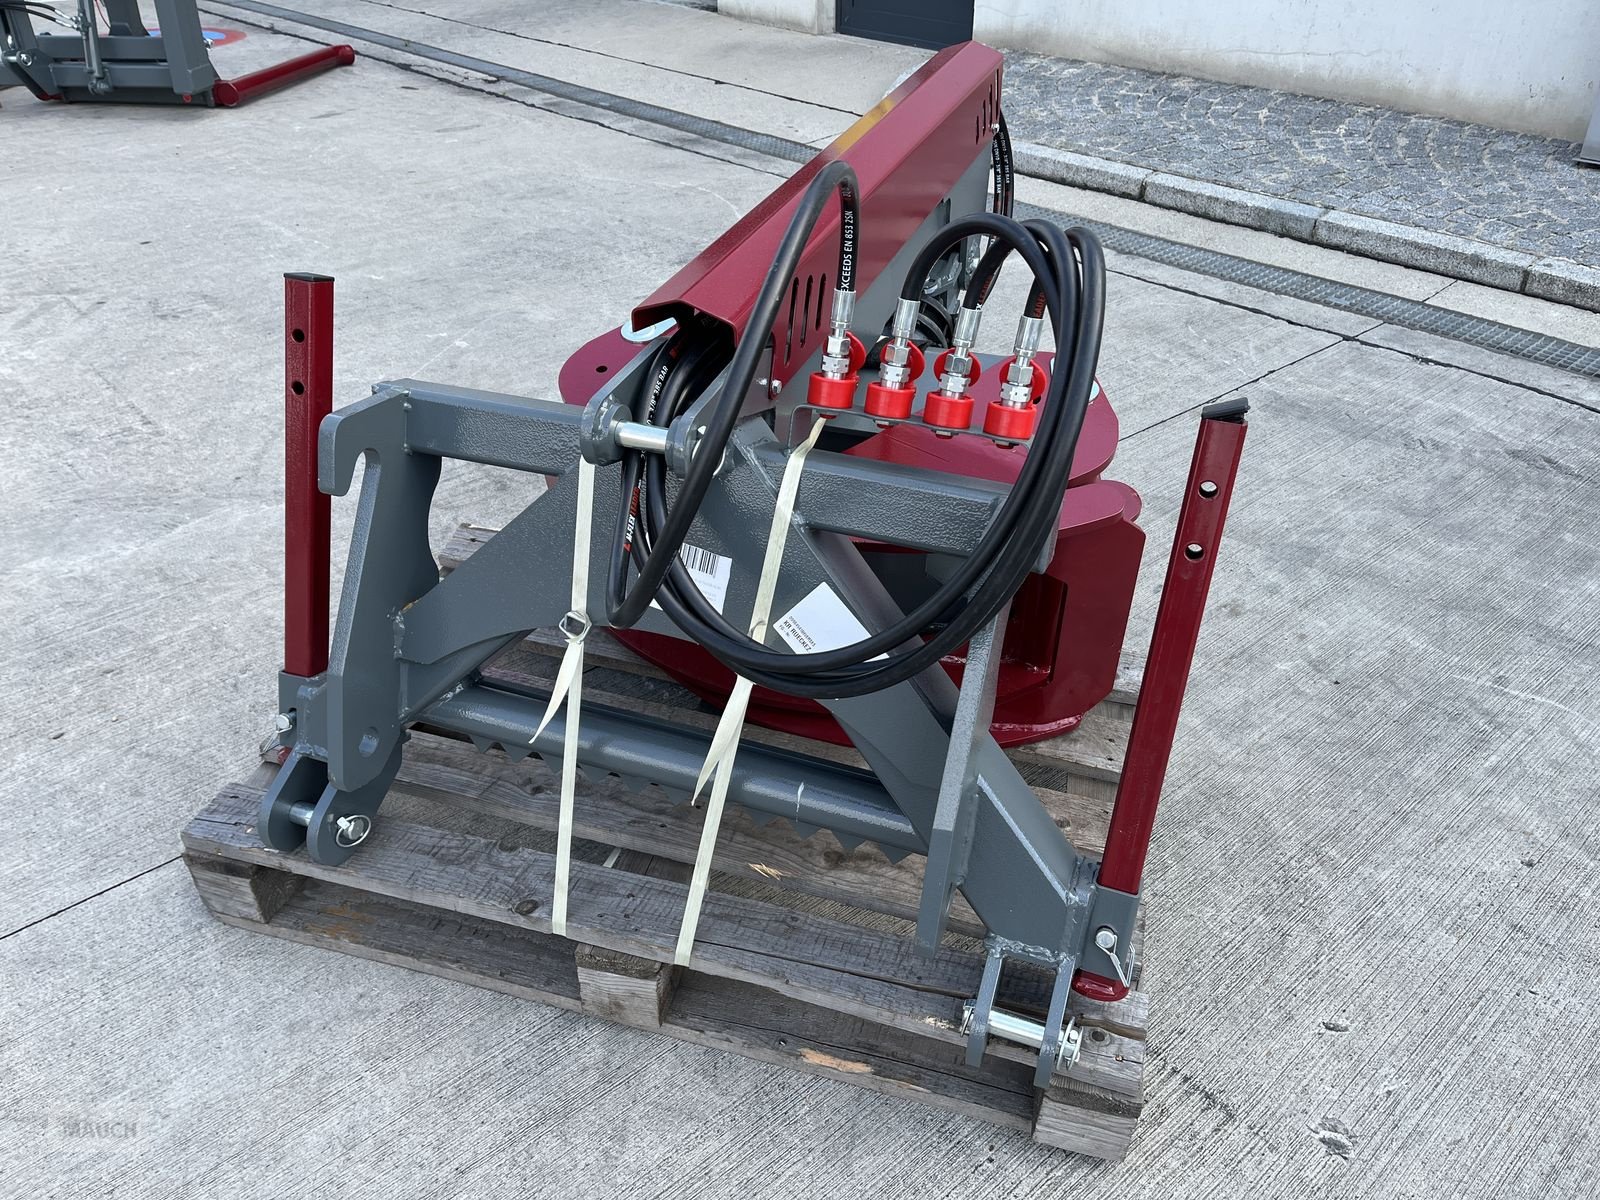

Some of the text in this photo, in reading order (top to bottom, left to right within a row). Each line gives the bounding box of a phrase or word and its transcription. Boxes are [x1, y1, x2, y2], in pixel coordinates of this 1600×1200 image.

[844, 210, 854, 224] 2SN
[844, 224, 854, 239] 853
[843, 240, 853, 252] EN
[658, 365, 669, 381] BAR
[625, 513, 636, 543] M-FLEX
